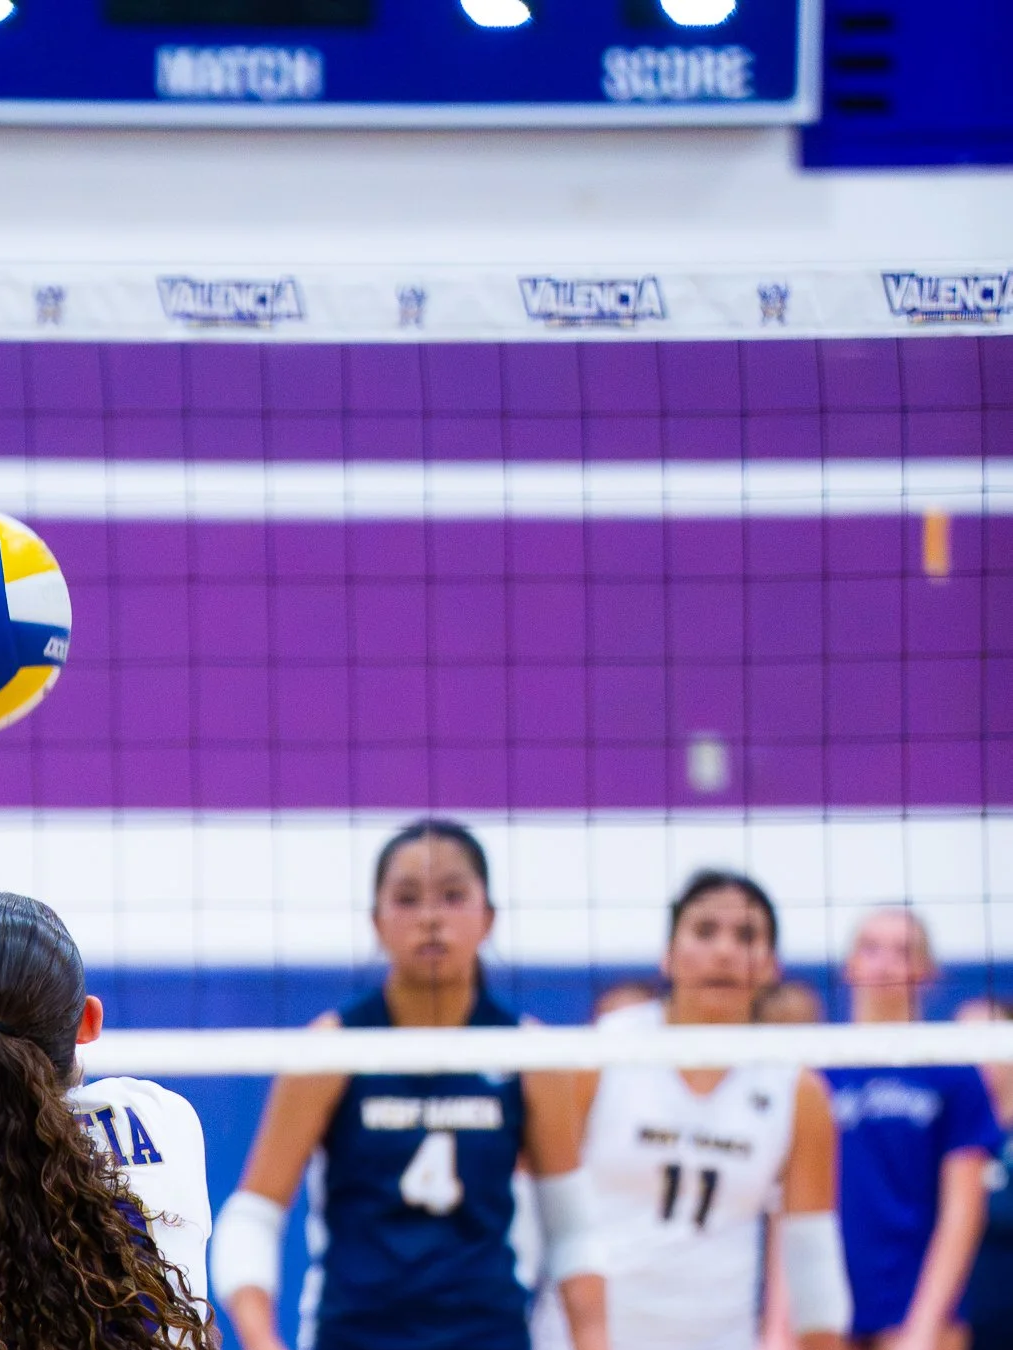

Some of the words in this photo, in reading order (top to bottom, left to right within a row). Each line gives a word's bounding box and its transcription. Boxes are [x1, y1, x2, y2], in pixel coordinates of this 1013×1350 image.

[155, 46, 321, 98] MATCH
[601, 46, 753, 100] SCORE
[517, 273, 668, 321] VALENCIA
[399, 1130, 464, 1216] 4
[661, 1163, 718, 1229] 11
